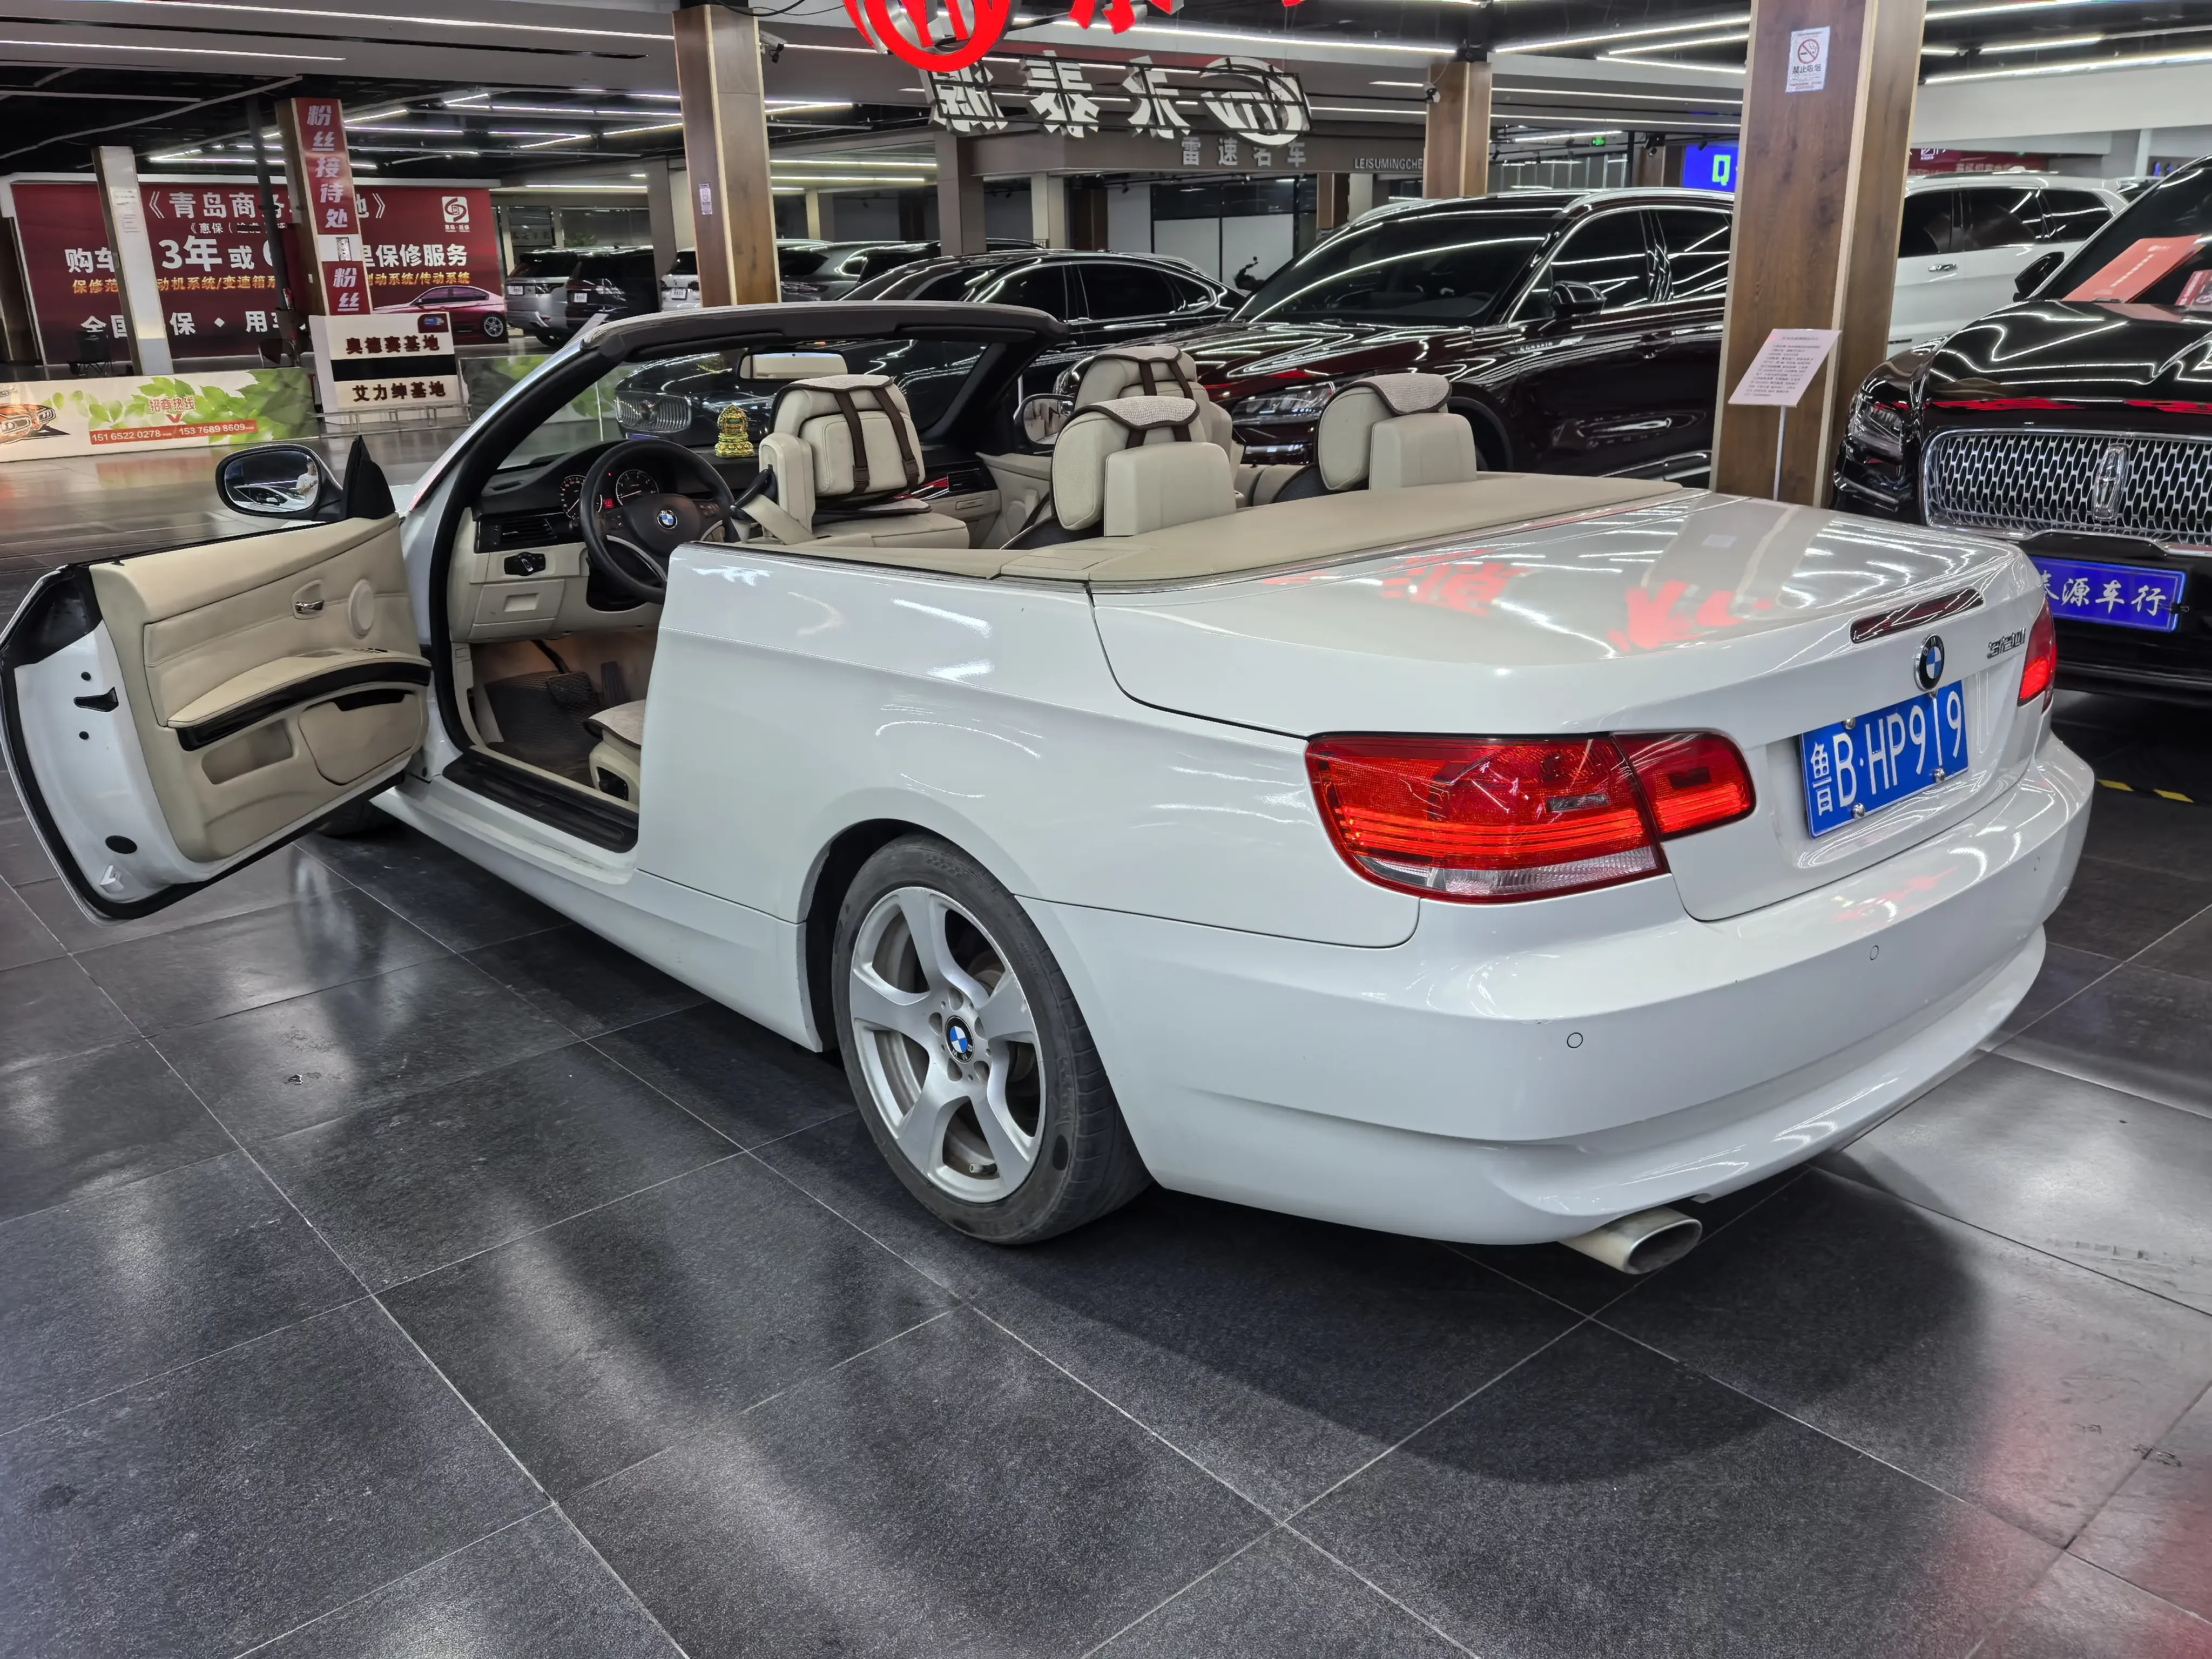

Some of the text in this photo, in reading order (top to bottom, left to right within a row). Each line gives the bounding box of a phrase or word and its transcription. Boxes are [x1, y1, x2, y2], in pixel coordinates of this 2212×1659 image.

[1182, 136, 1306, 167] 雷速名车
[307, 105, 348, 228] 粉丝接待处
[333, 267, 360, 312] 粉丝
[170, 312, 196, 335] 保
[346, 334, 440, 355] 奥德赛基地
[352, 380, 447, 402] 艾力绅基地
[149, 397, 196, 413] 招商热线
[111, 431, 134, 440] 6522
[137, 430, 161, 439] 0278
[179, 427, 195, 435] 153
[198, 425, 220, 434] 7689
[951, 1043, 973, 1061] BMW
